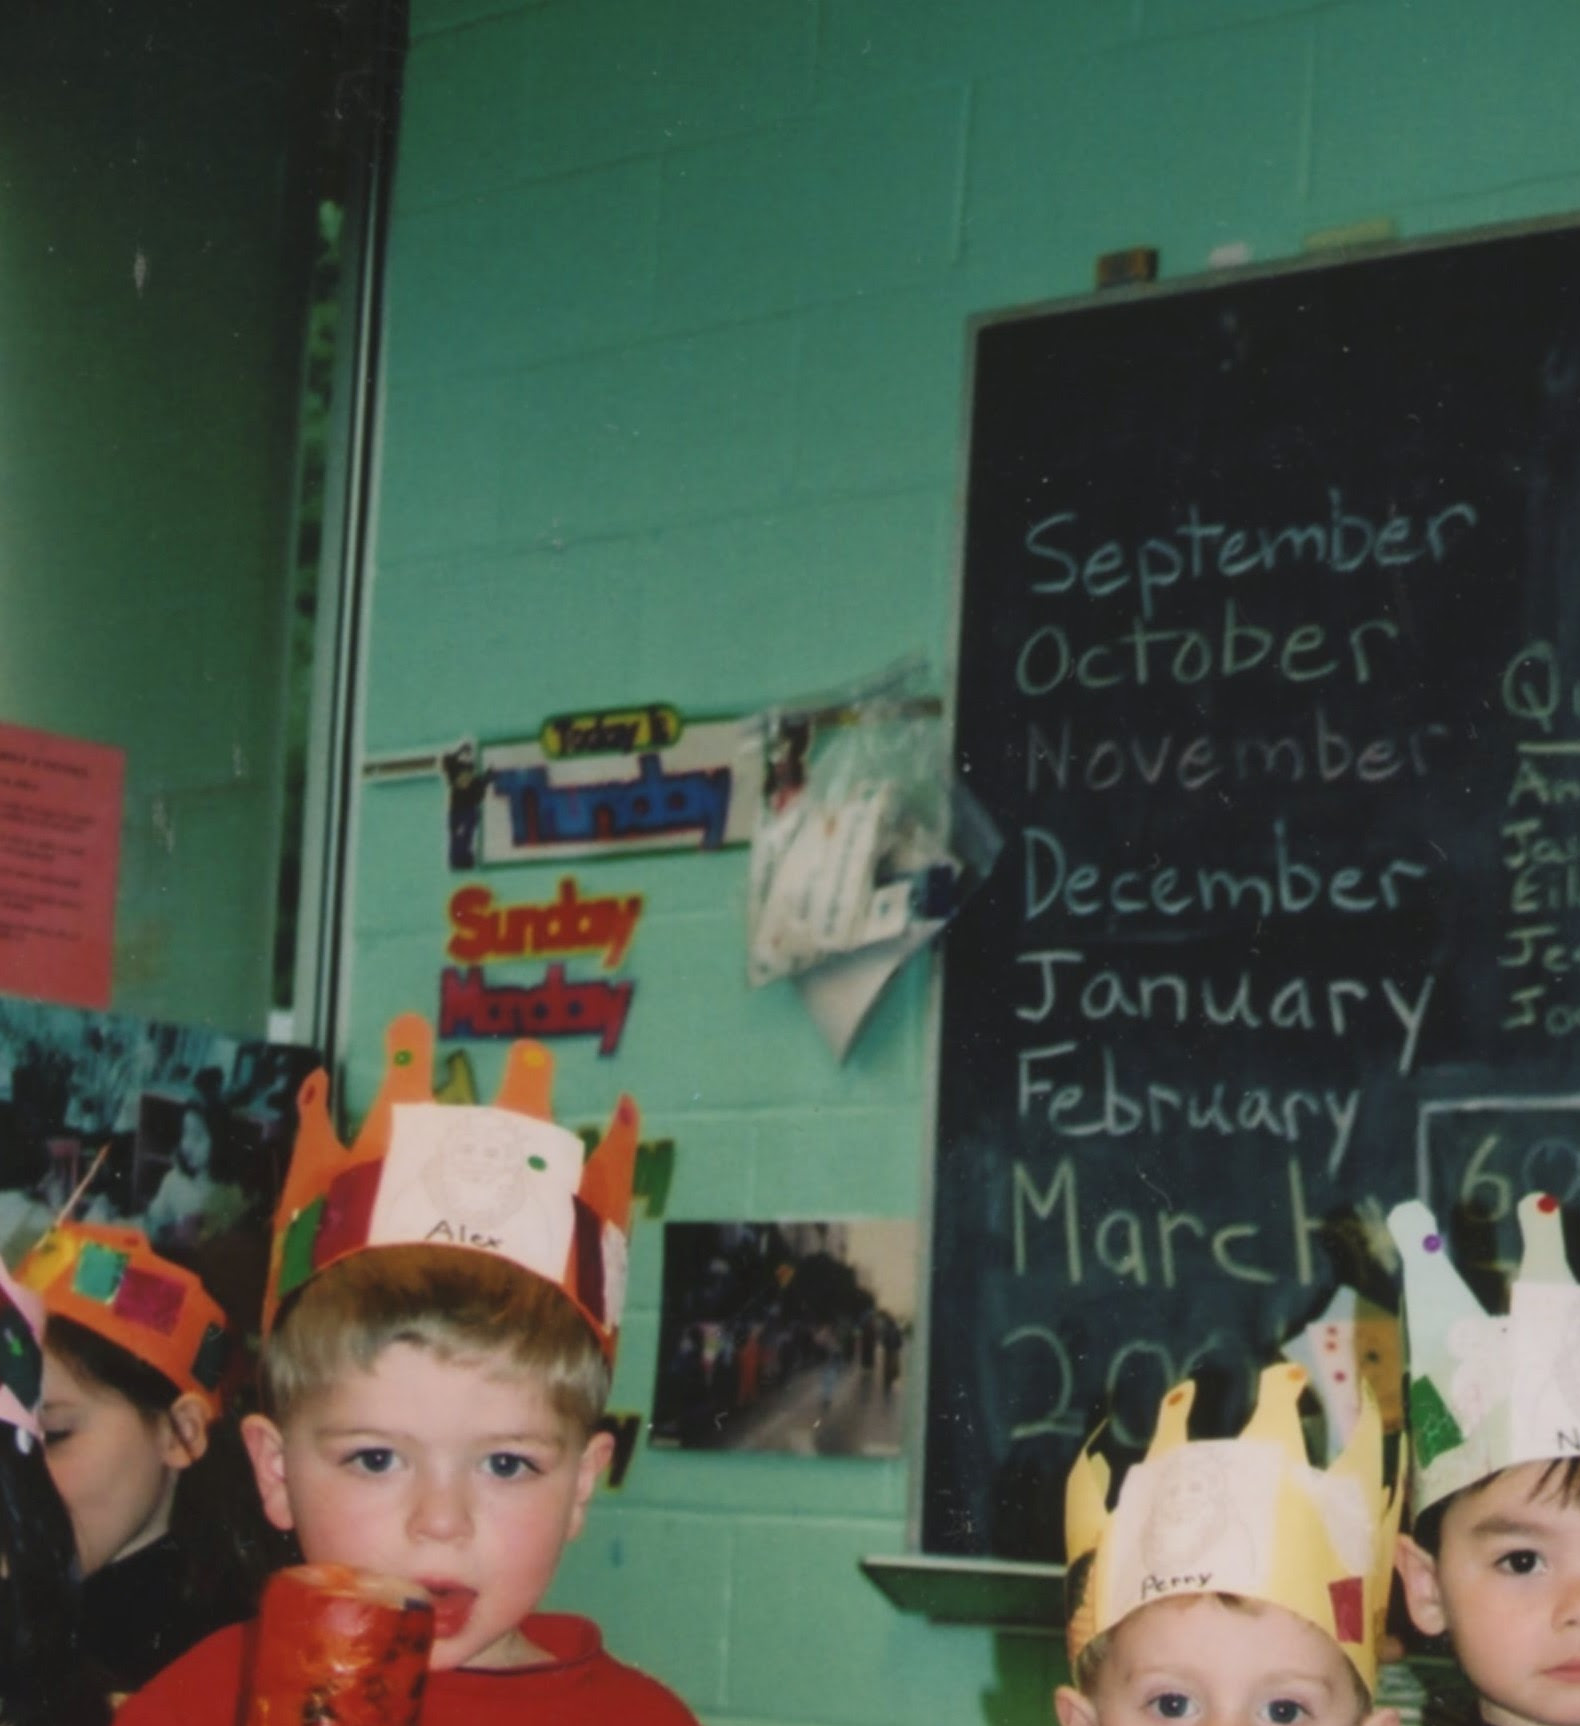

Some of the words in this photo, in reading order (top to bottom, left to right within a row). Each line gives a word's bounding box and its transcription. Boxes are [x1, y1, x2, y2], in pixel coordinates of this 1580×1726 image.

[1025, 488, 1478, 620] September
[1014, 599, 1398, 696] October
[1025, 707, 1449, 795] November
[1022, 819, 1427, 921] December
[447, 876, 645, 969] Sunday
[438, 964, 637, 1058] Monday
[1016, 950, 1435, 1077] January
[1017, 1042, 1360, 1177] February
[424, 1219, 503, 1249] Alex
[1141, 1573, 1213, 1602] Perry
